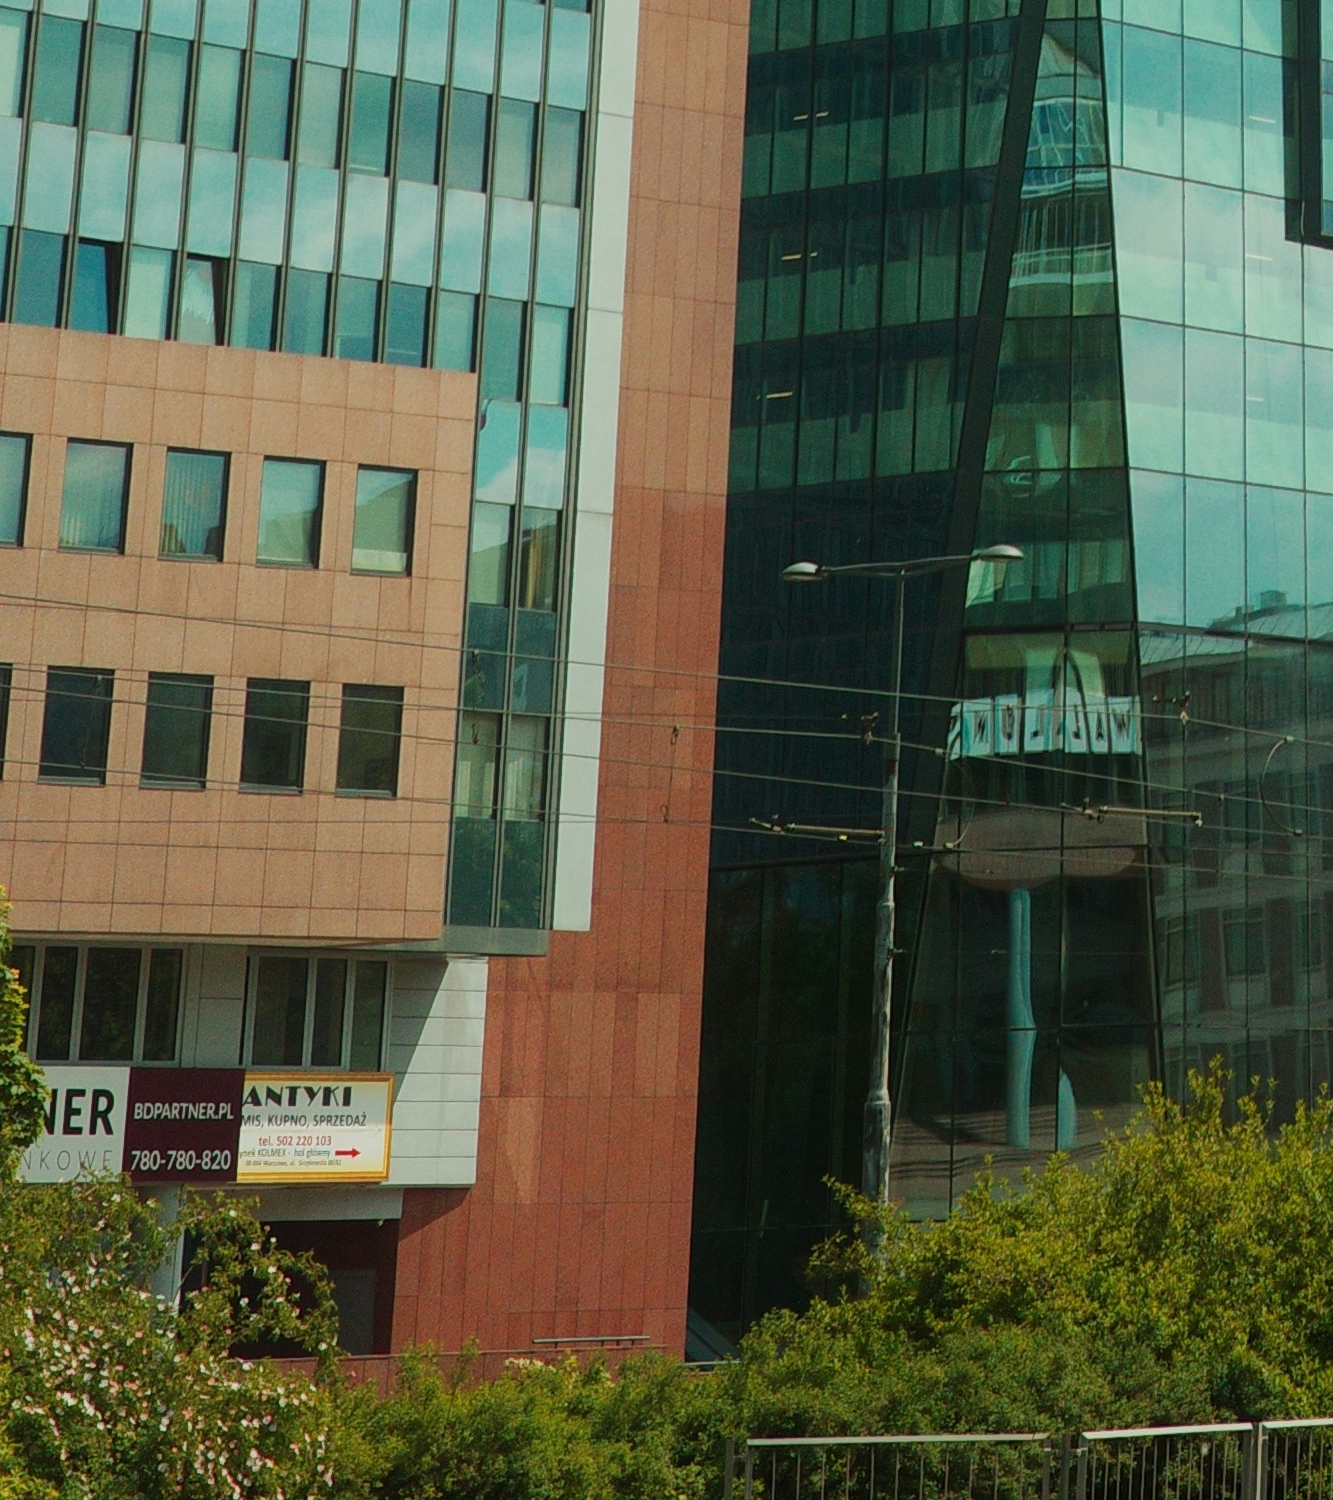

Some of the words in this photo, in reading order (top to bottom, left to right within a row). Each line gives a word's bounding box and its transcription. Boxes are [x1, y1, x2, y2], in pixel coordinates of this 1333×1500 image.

[241, 1085, 353, 1108] ANTYKI
[133, 1102, 235, 1121] BDPARTNER.PL
[267, 1114, 310, 1129] KUPNO,
[276, 1135, 293, 1147] 502
[296, 1135, 313, 1147] 220
[315, 1135, 332, 1147] 103
[130, 1149, 232, 1172] 780-780-820
